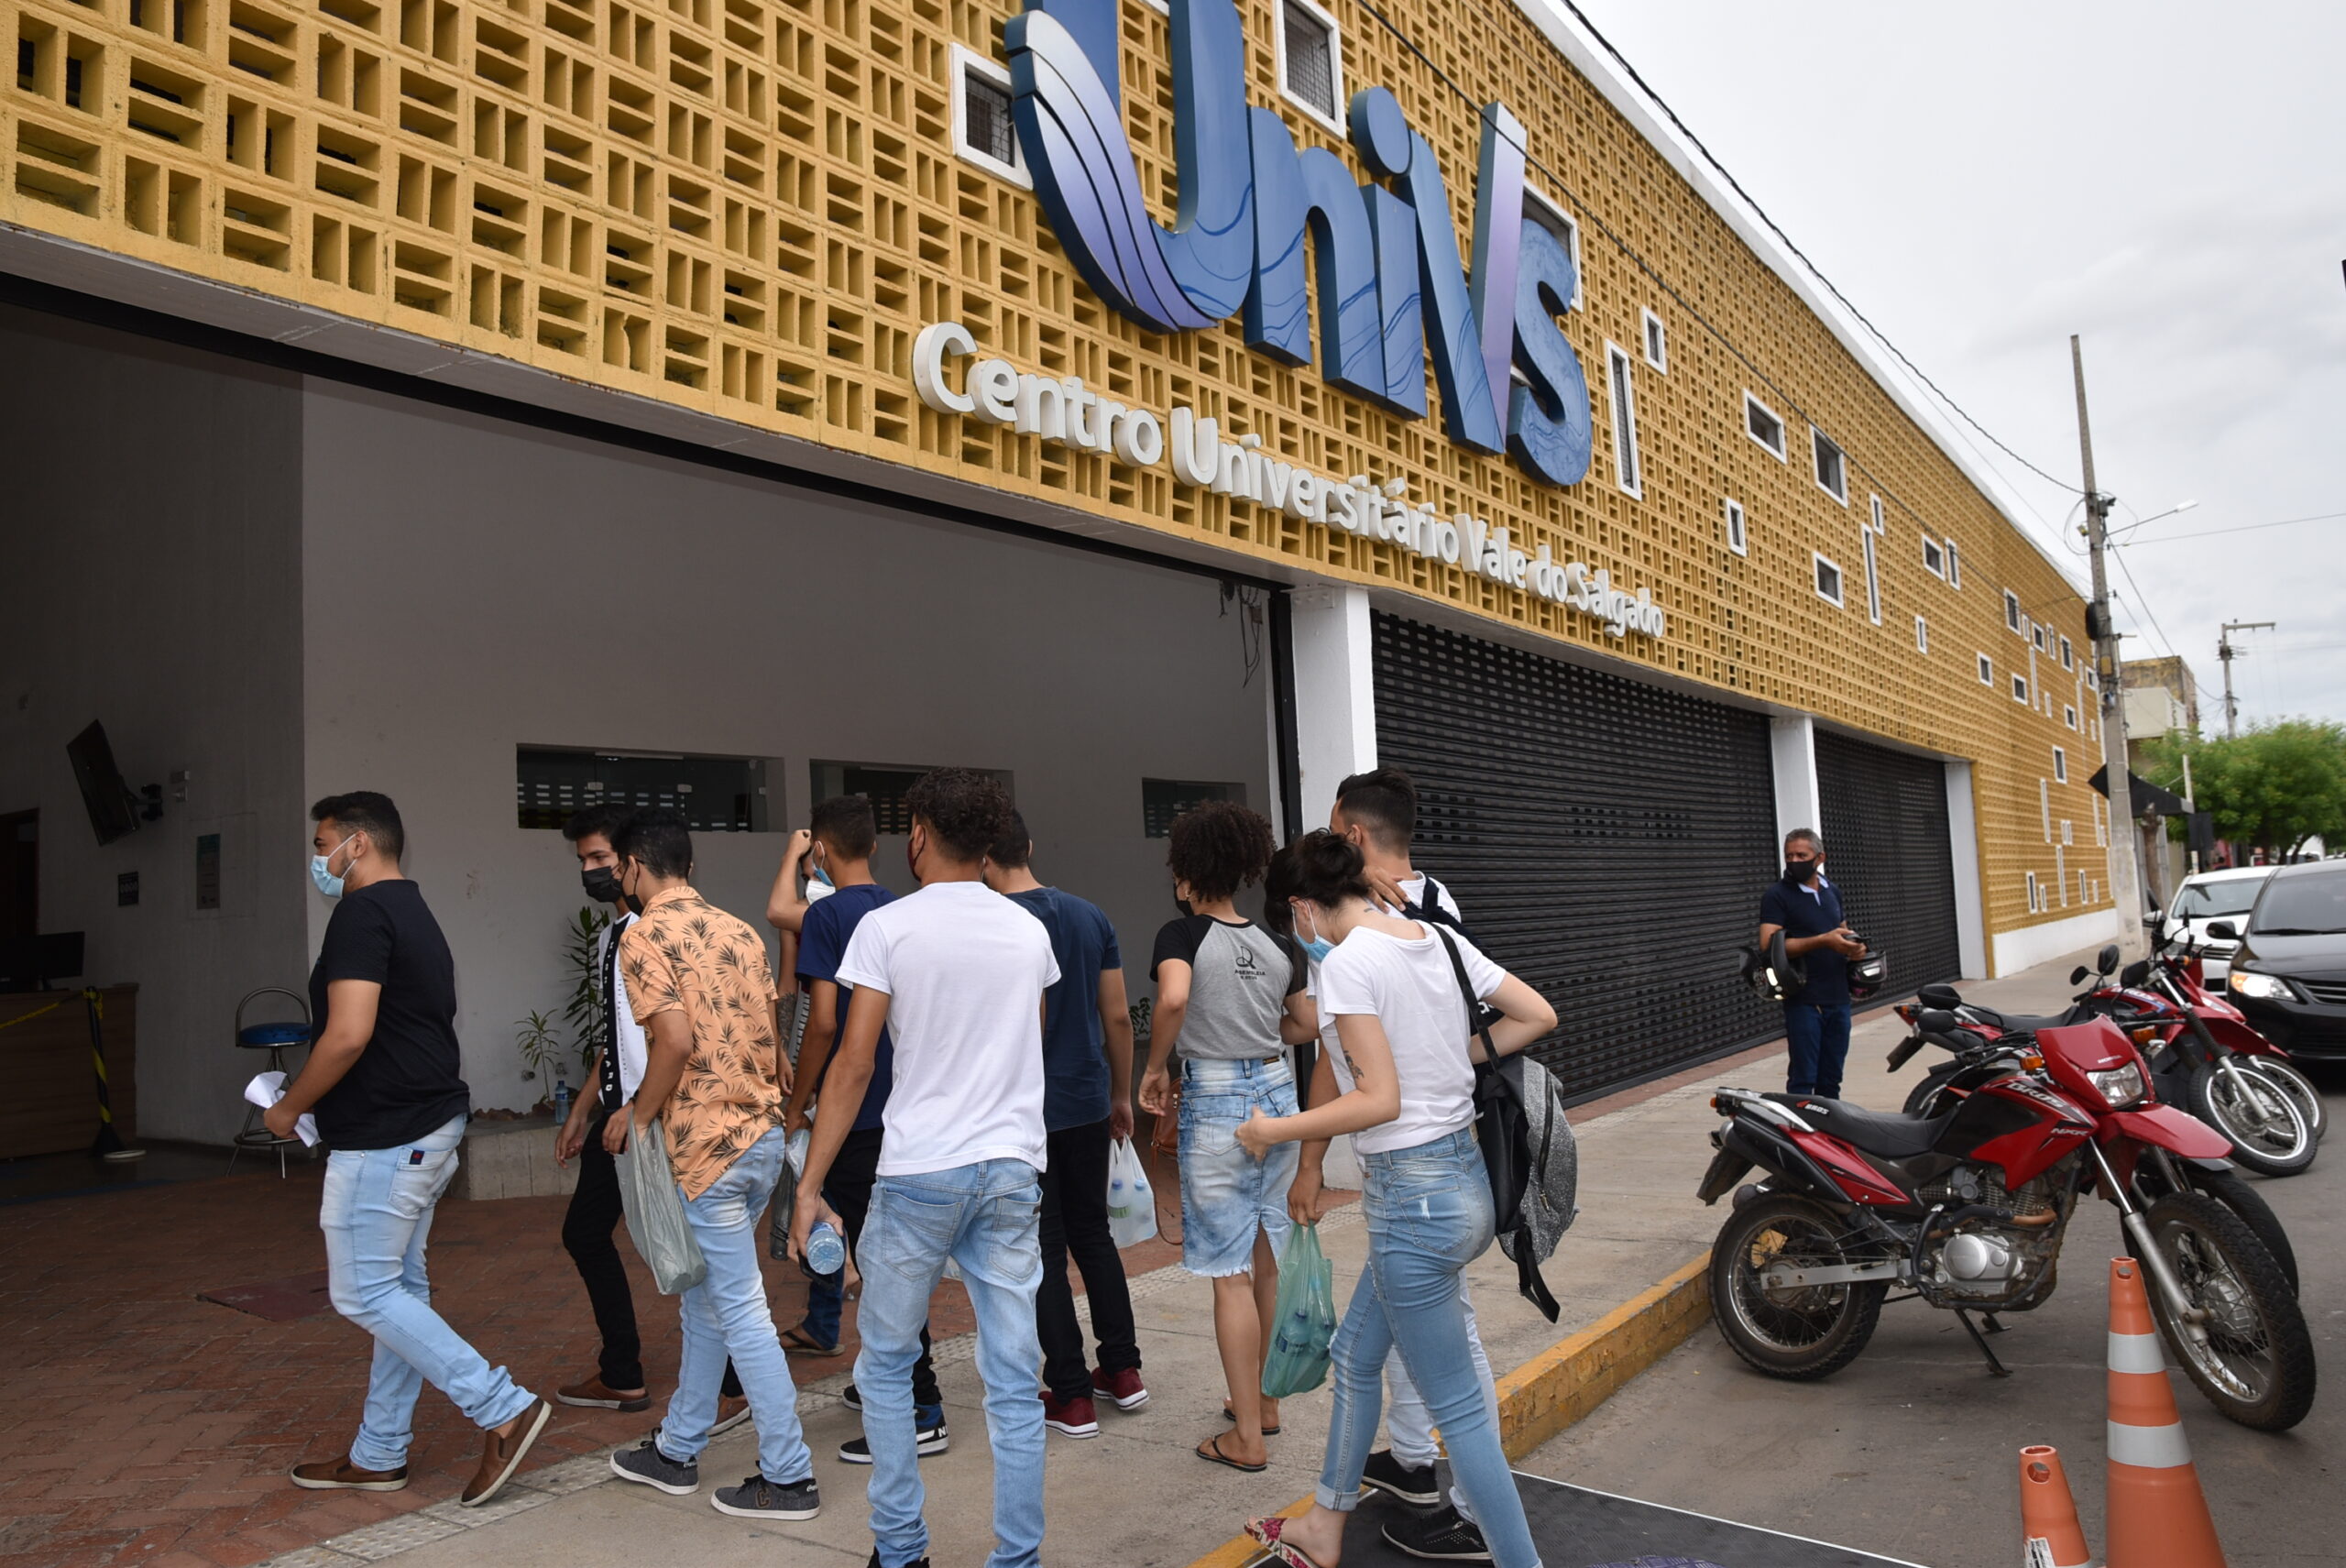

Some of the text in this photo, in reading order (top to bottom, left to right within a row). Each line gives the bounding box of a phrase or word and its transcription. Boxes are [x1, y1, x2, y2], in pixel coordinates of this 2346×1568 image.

[913, 321, 1664, 639] Centro Universitário Vale do Salgado
[2005, 1081, 2068, 1108] BROS
[2050, 1127, 2089, 1137] NXR
